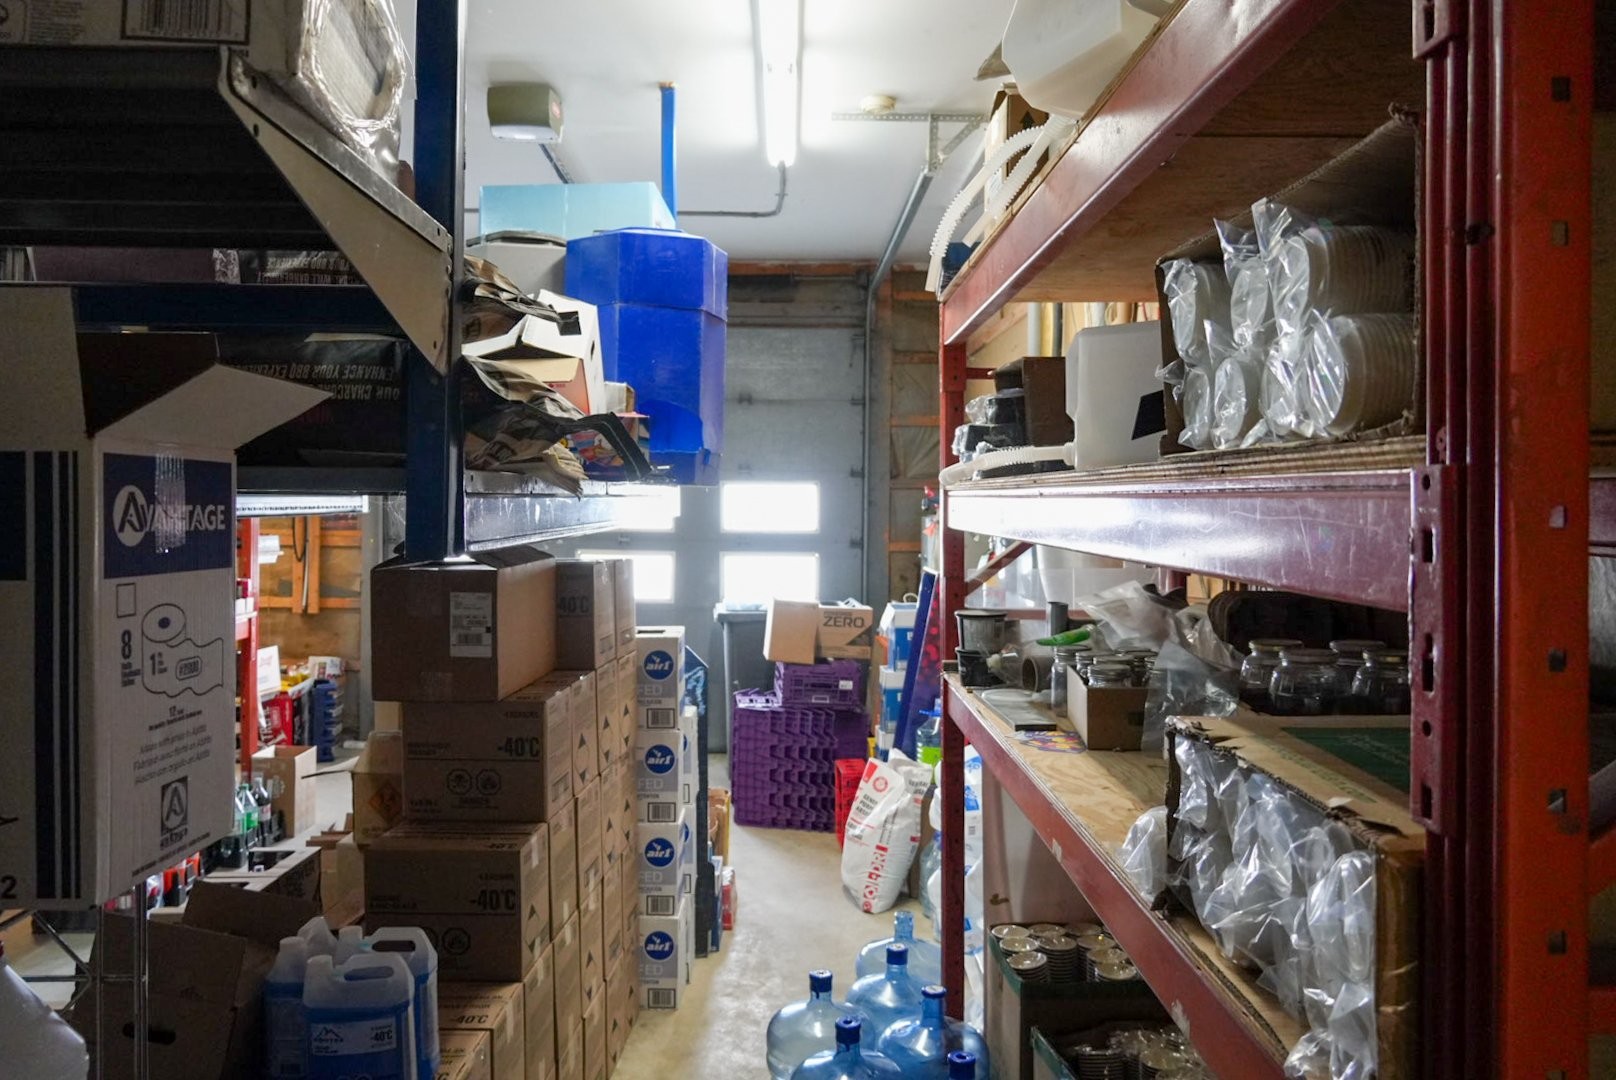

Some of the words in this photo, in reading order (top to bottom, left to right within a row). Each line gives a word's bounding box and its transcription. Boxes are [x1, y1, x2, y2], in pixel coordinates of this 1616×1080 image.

[290, 363, 309, 378] BBQ
[312, 364, 340, 379] YOUR
[823, 616, 864, 628] ZERO
[121, 629, 132, 660] 8
